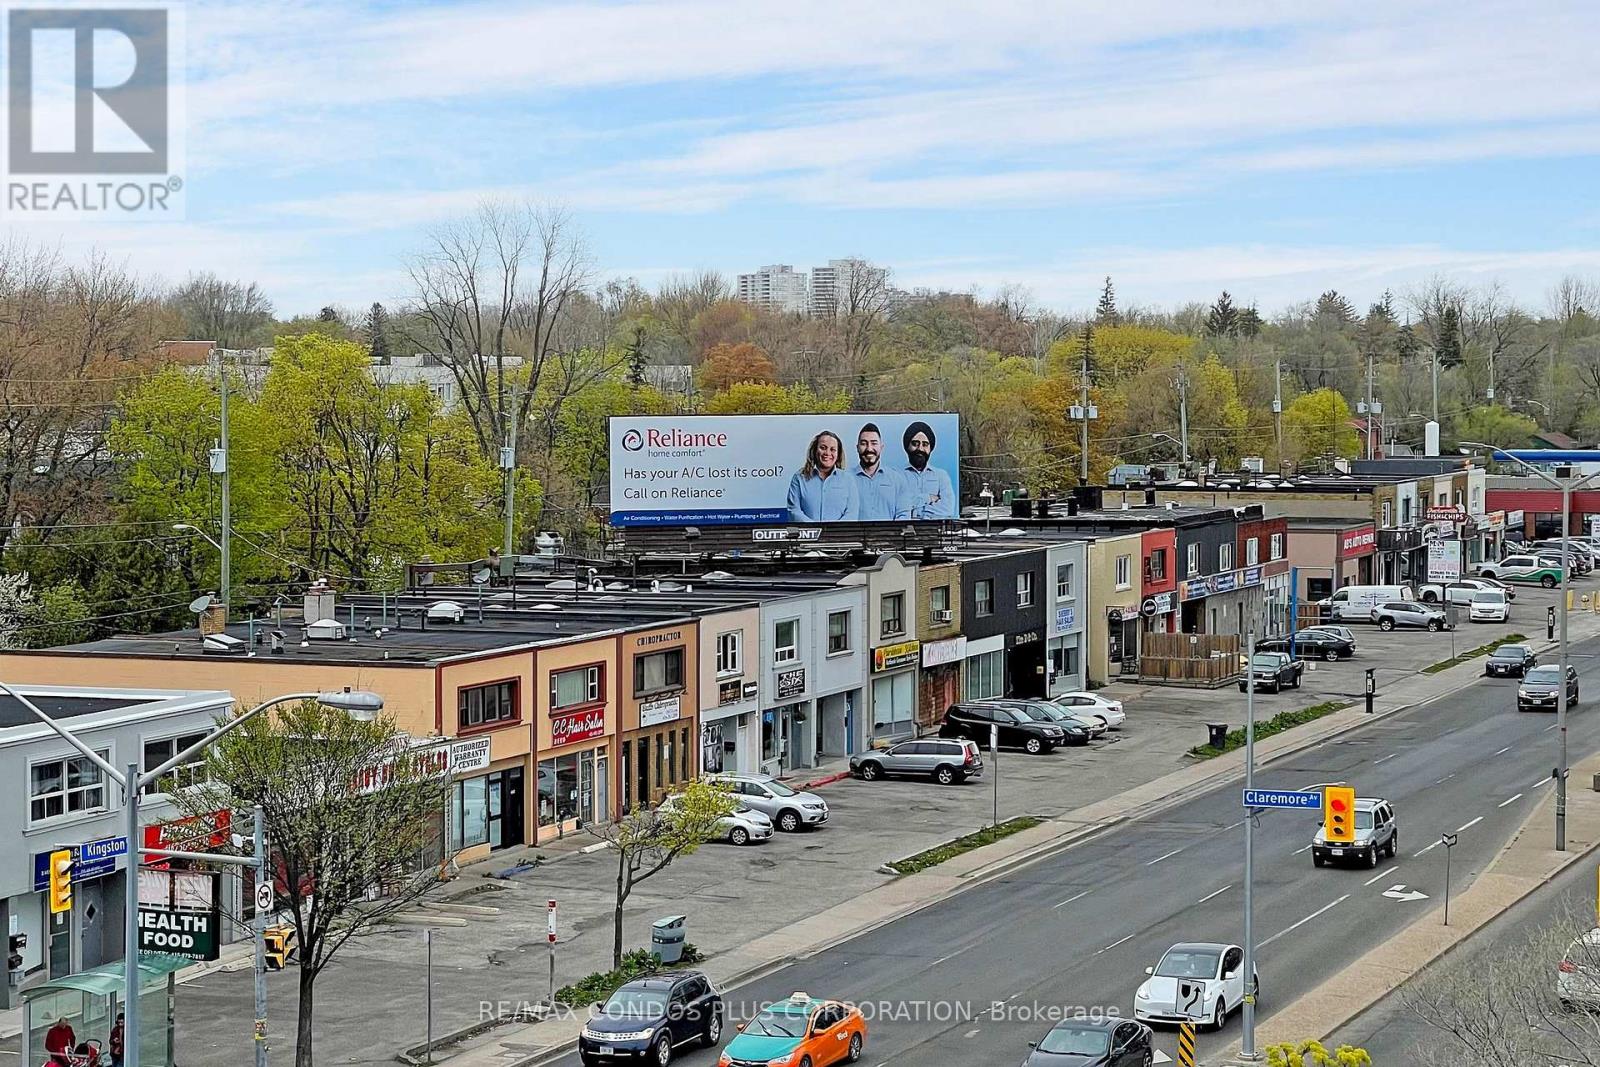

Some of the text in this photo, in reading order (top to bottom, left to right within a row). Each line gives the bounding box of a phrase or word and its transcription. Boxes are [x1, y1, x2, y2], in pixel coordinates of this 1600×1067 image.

[647, 428, 727, 448] Reliance
[648, 449, 670, 458] home
[623, 465, 784, 481] Has your A/C lost its cool?
[623, 487, 648, 499] Call
[651, 490, 667, 499] on
[734, 513, 756, 521] Plumbing
[636, 631, 682, 647] CHIROPRACTOR
[566, 718, 584, 738] Hair
[584, 712, 604, 732] Salon
[452, 739, 489, 754] AUTHORIZED
[454, 749, 487, 762] WARRANTY
[457, 758, 482, 770] CENTRE
[1246, 791, 1318, 805] Claremore Av
[87, 839, 126, 857] Kingston
[143, 931, 194, 948] FOOD
